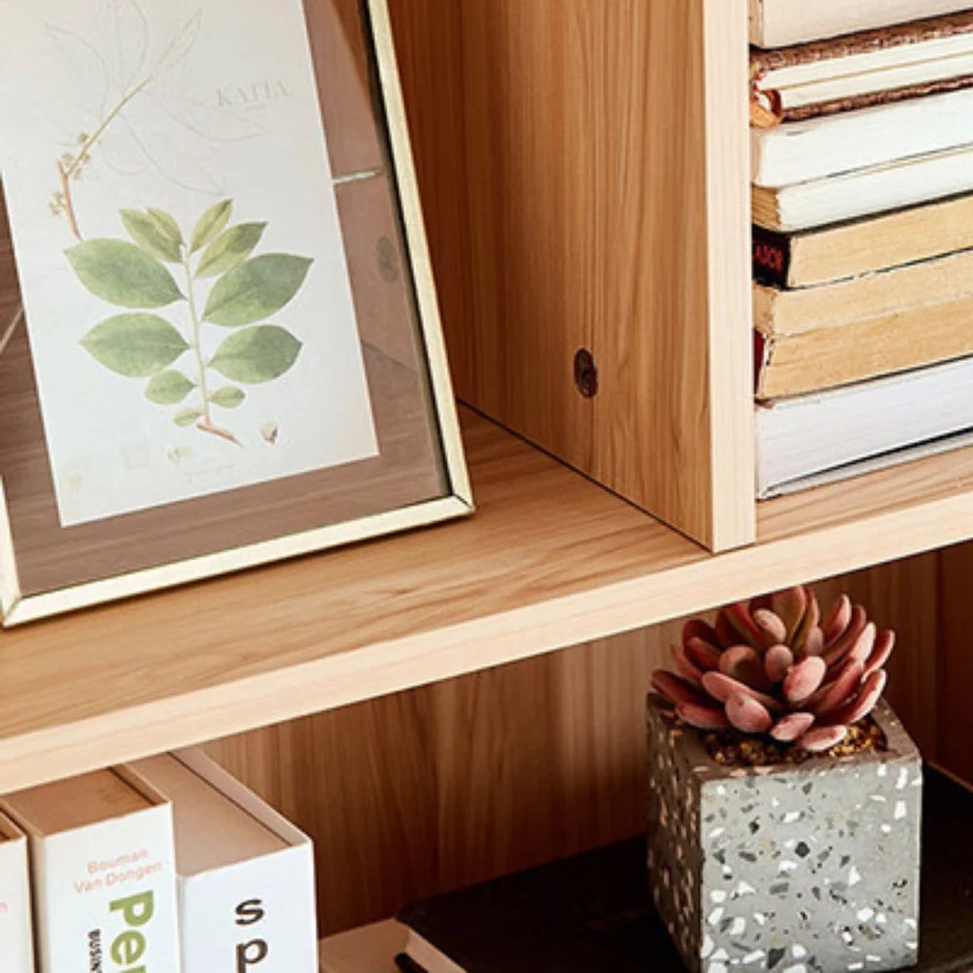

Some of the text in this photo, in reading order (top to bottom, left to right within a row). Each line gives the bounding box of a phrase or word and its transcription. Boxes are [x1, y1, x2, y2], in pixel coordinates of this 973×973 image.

[73, 862, 163, 895] Van Dongen
[87, 848, 149, 876] Bouman
[109, 890, 155, 973] Pe
